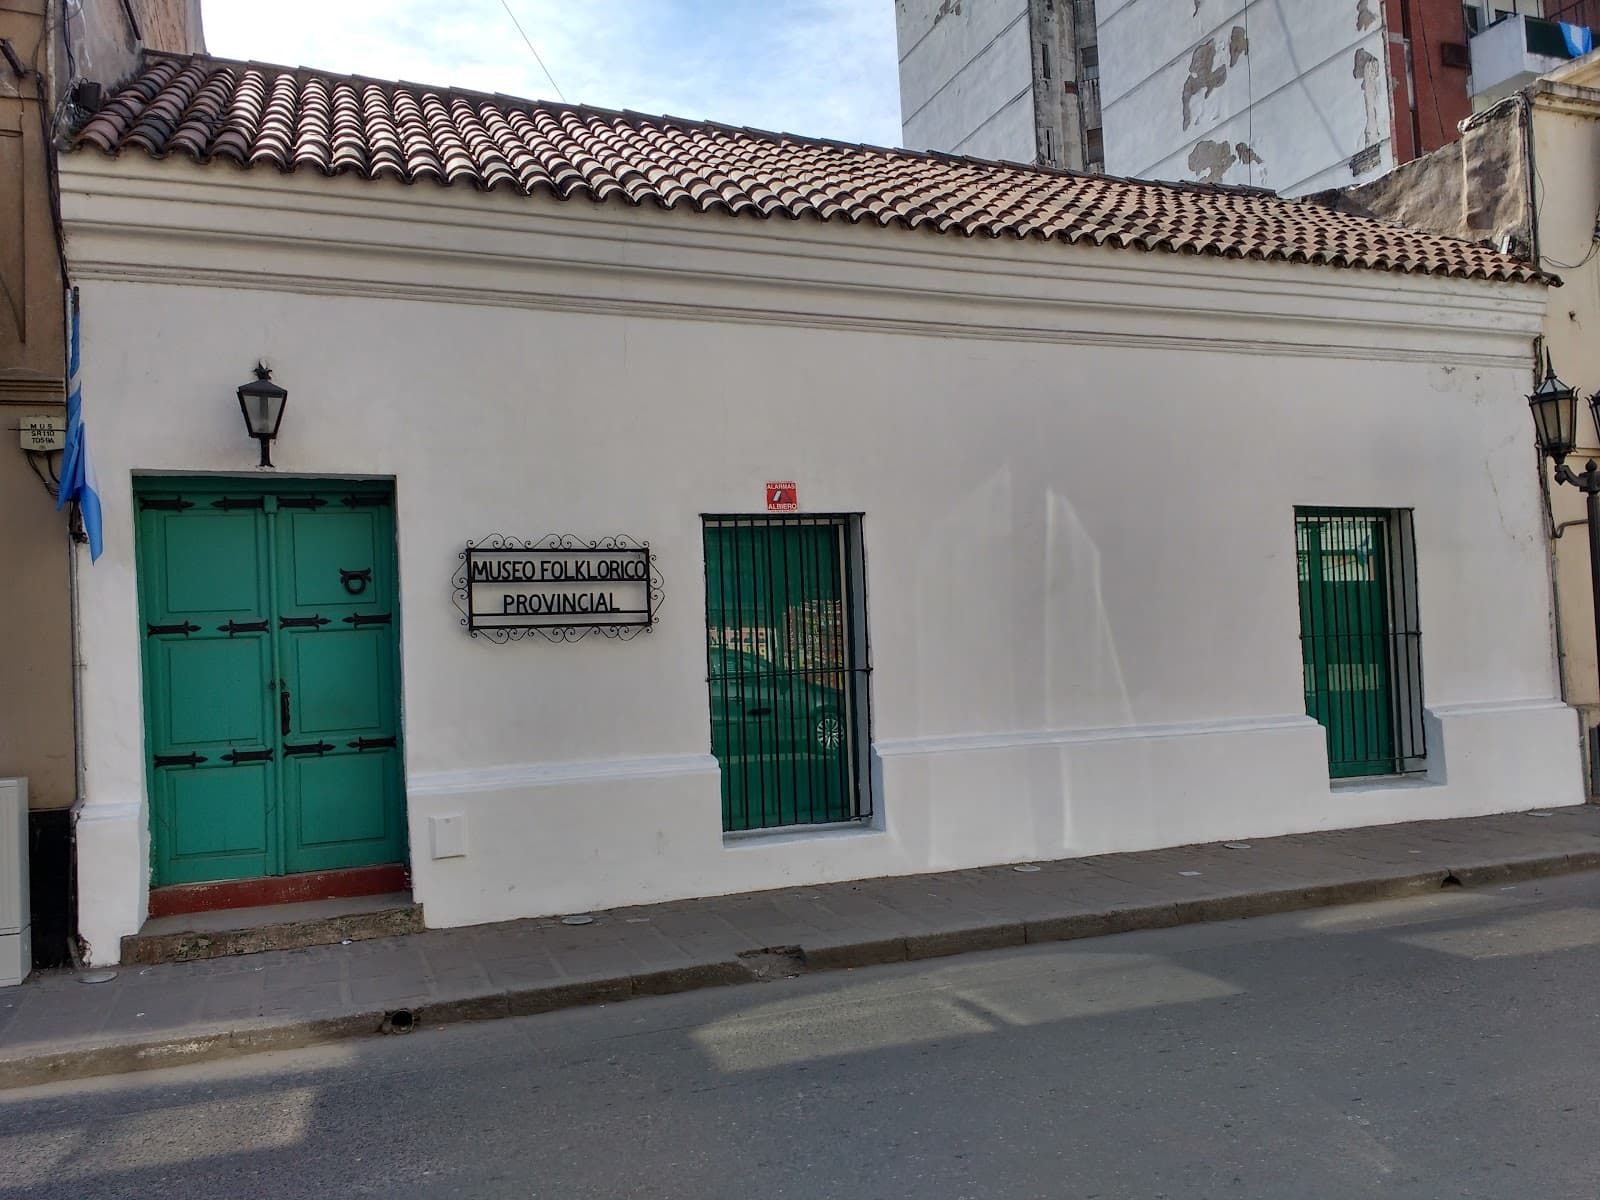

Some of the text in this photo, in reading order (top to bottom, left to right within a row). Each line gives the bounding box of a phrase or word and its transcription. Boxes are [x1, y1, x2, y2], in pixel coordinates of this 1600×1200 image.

[472, 559, 647, 581] MUSEO FOLKLORICO
[503, 591, 620, 614] PROVINCIAL
